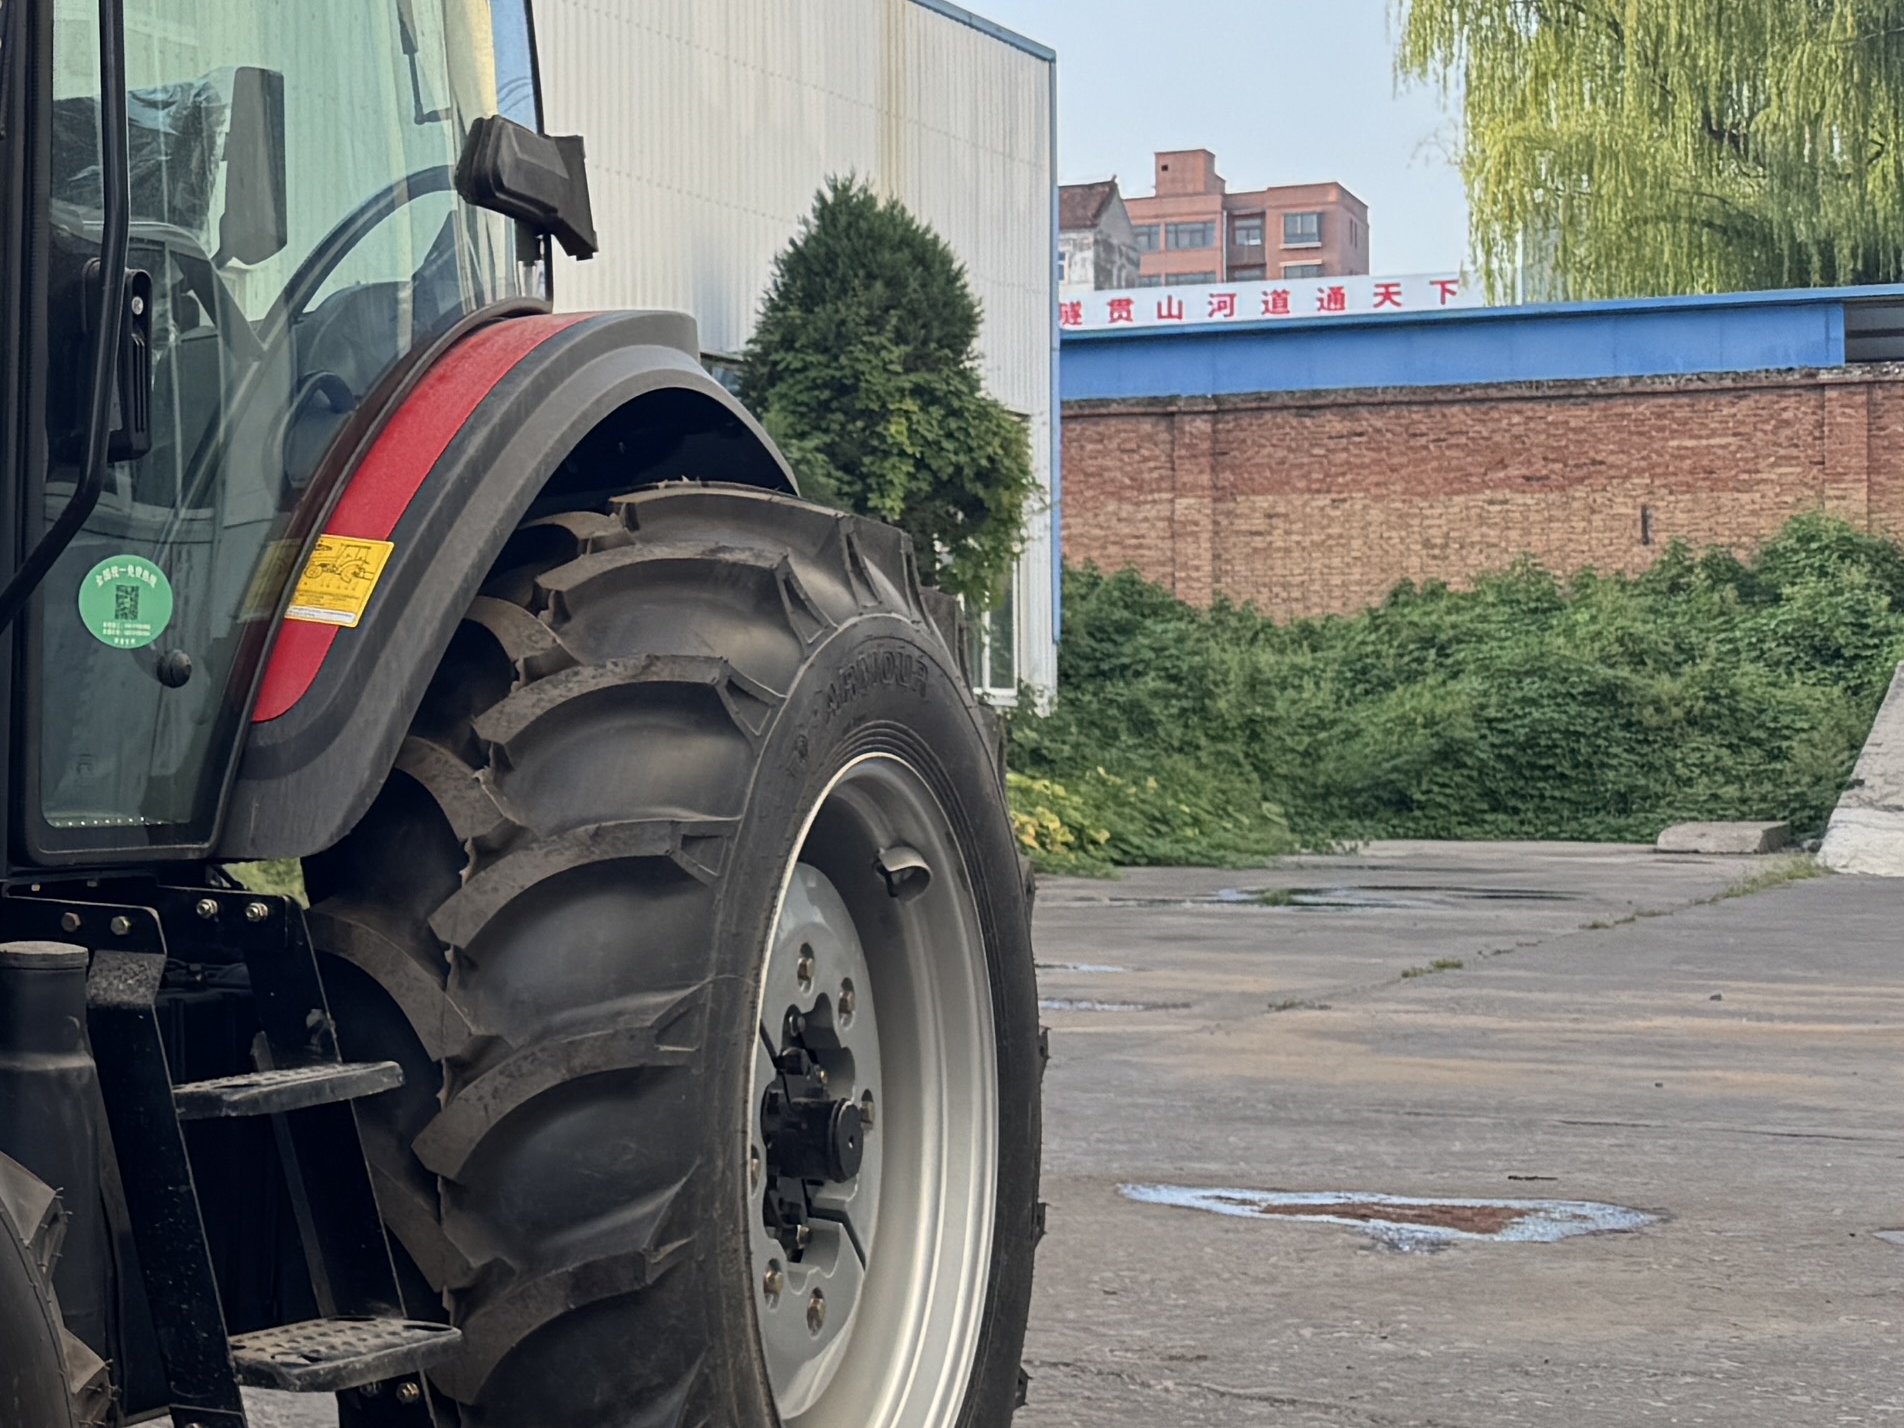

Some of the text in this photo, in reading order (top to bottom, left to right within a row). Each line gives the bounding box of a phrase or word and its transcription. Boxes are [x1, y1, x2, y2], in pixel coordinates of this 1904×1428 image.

[1059, 279, 1458, 325] 隧贯山河道通天下
